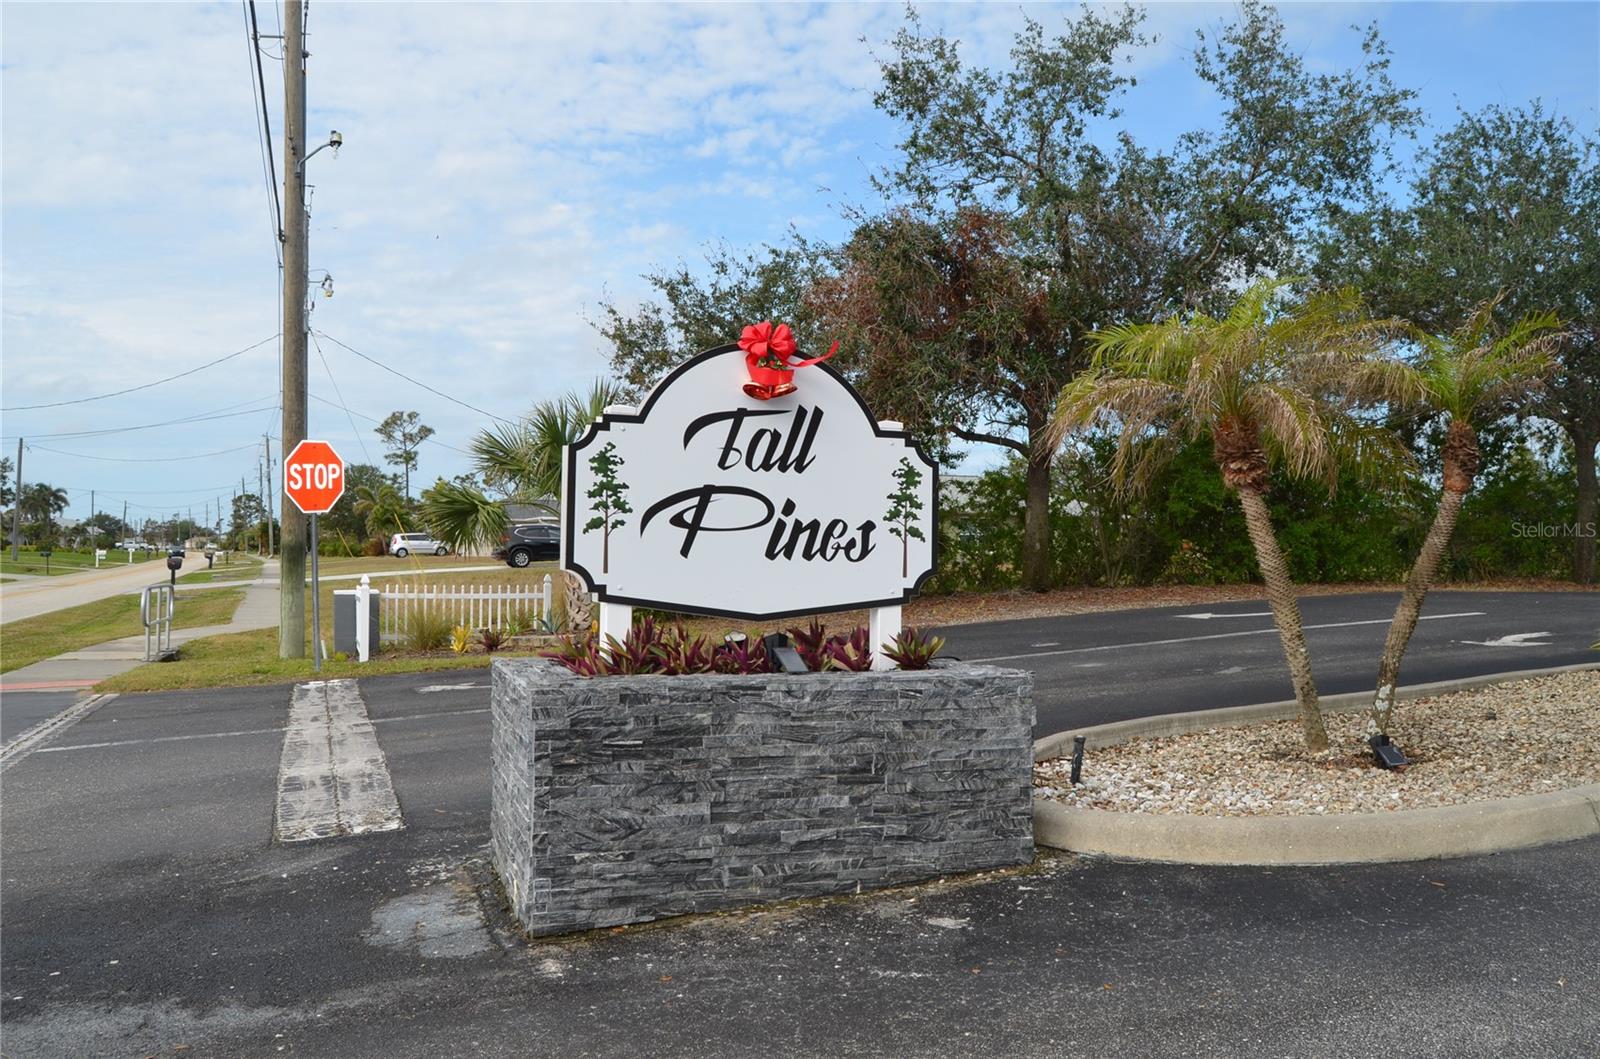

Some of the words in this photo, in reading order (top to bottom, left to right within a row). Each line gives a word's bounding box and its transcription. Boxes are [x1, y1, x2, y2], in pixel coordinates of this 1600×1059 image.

[683, 405, 824, 474] Tall
[289, 463, 341, 490] STOP
[640, 484, 878, 562] Pines
